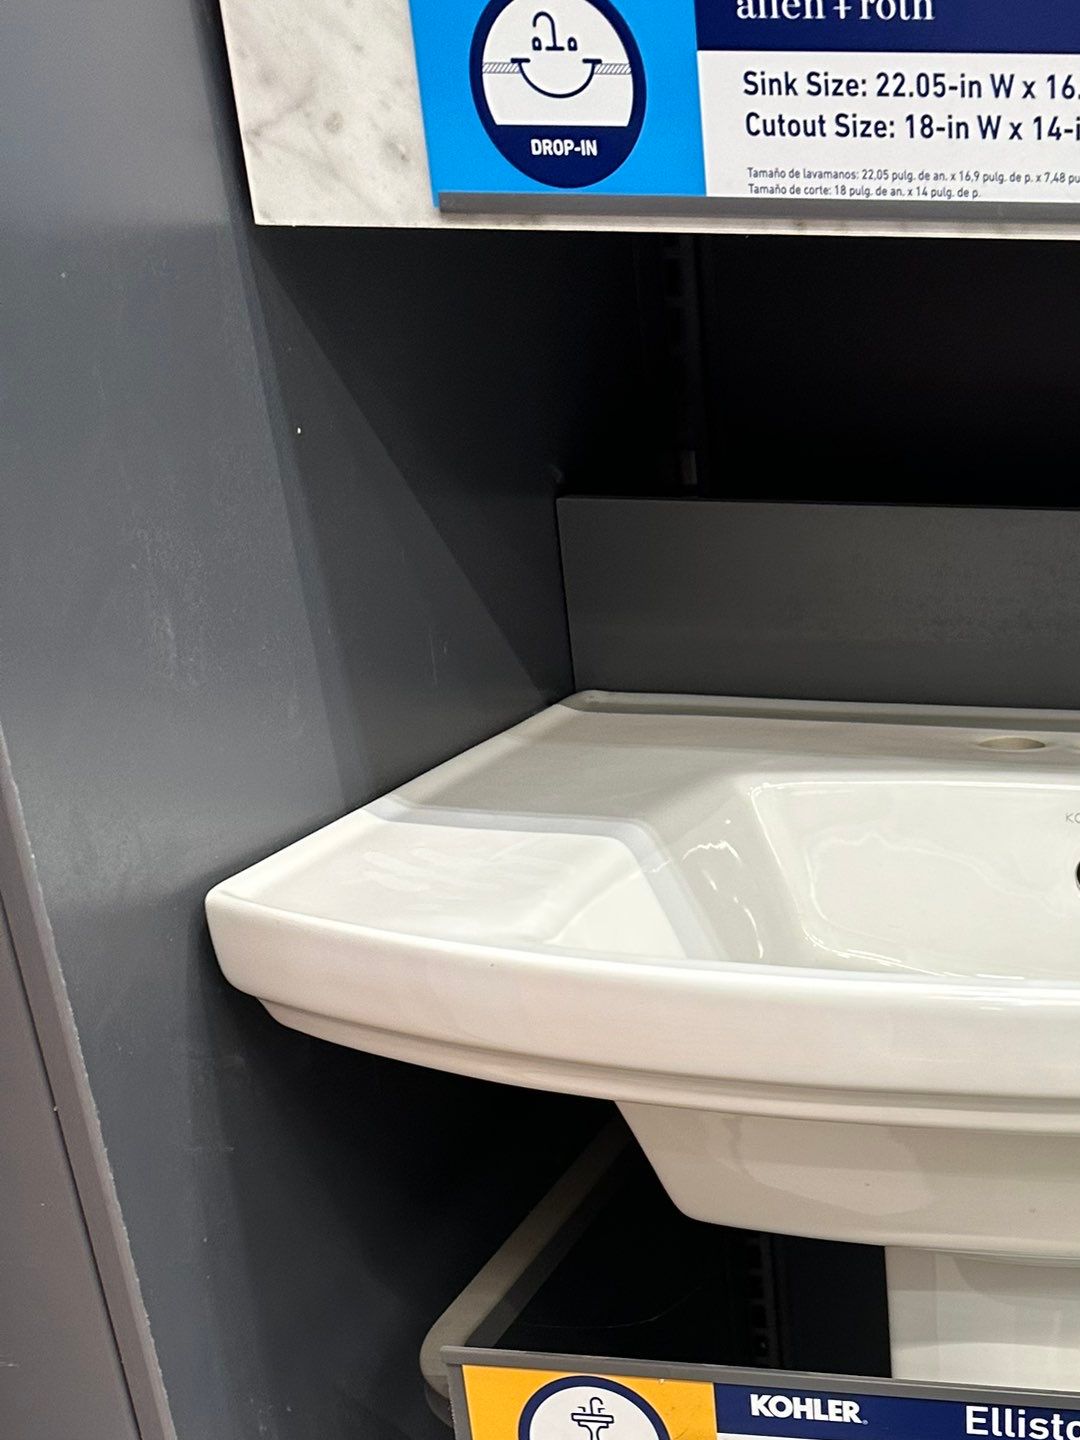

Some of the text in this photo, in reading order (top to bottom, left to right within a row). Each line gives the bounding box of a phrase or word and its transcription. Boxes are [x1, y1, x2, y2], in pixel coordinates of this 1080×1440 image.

[736, 0, 826, 19] allen
[860, 0, 935, 21] roth
[743, 71, 798, 96] Sink
[806, 71, 867, 97] Size:
[876, 72, 982, 98] 22.05-in
[990, 73, 1015, 98] W
[1022, 80, 1036, 99] x
[745, 112, 826, 137] Cutout
[835, 113, 895, 138] Size:
[905, 114, 969, 139] 18-in
[977, 115, 1001, 140] W
[1008, 121, 1023, 140] x
[530, 138, 598, 156] DROP-IN
[747, 167, 787, 179] Tamaño
[788, 168, 800, 180] de
[803, 168, 860, 180] lavamanos:
[862, 169, 889, 182] 22,05
[892, 169, 916, 183] pulg.
[918, 170, 931, 181] de
[933, 172, 947, 181] an.
[950, 173, 957, 181] x
[959, 171, 980, 183] 16,9
[983, 172, 1007, 184] pulg.
[1009, 172, 1022, 183] de
[1024, 174, 1034, 185] p.
[1035, 174, 1042, 183] x
[1044, 172, 1066, 184] 7,48
[748, 183, 981, 200] Tamaño de corte: 18 pulg. de an. x 14 pulg. de p.
[750, 1393, 863, 1424] KOHLER
